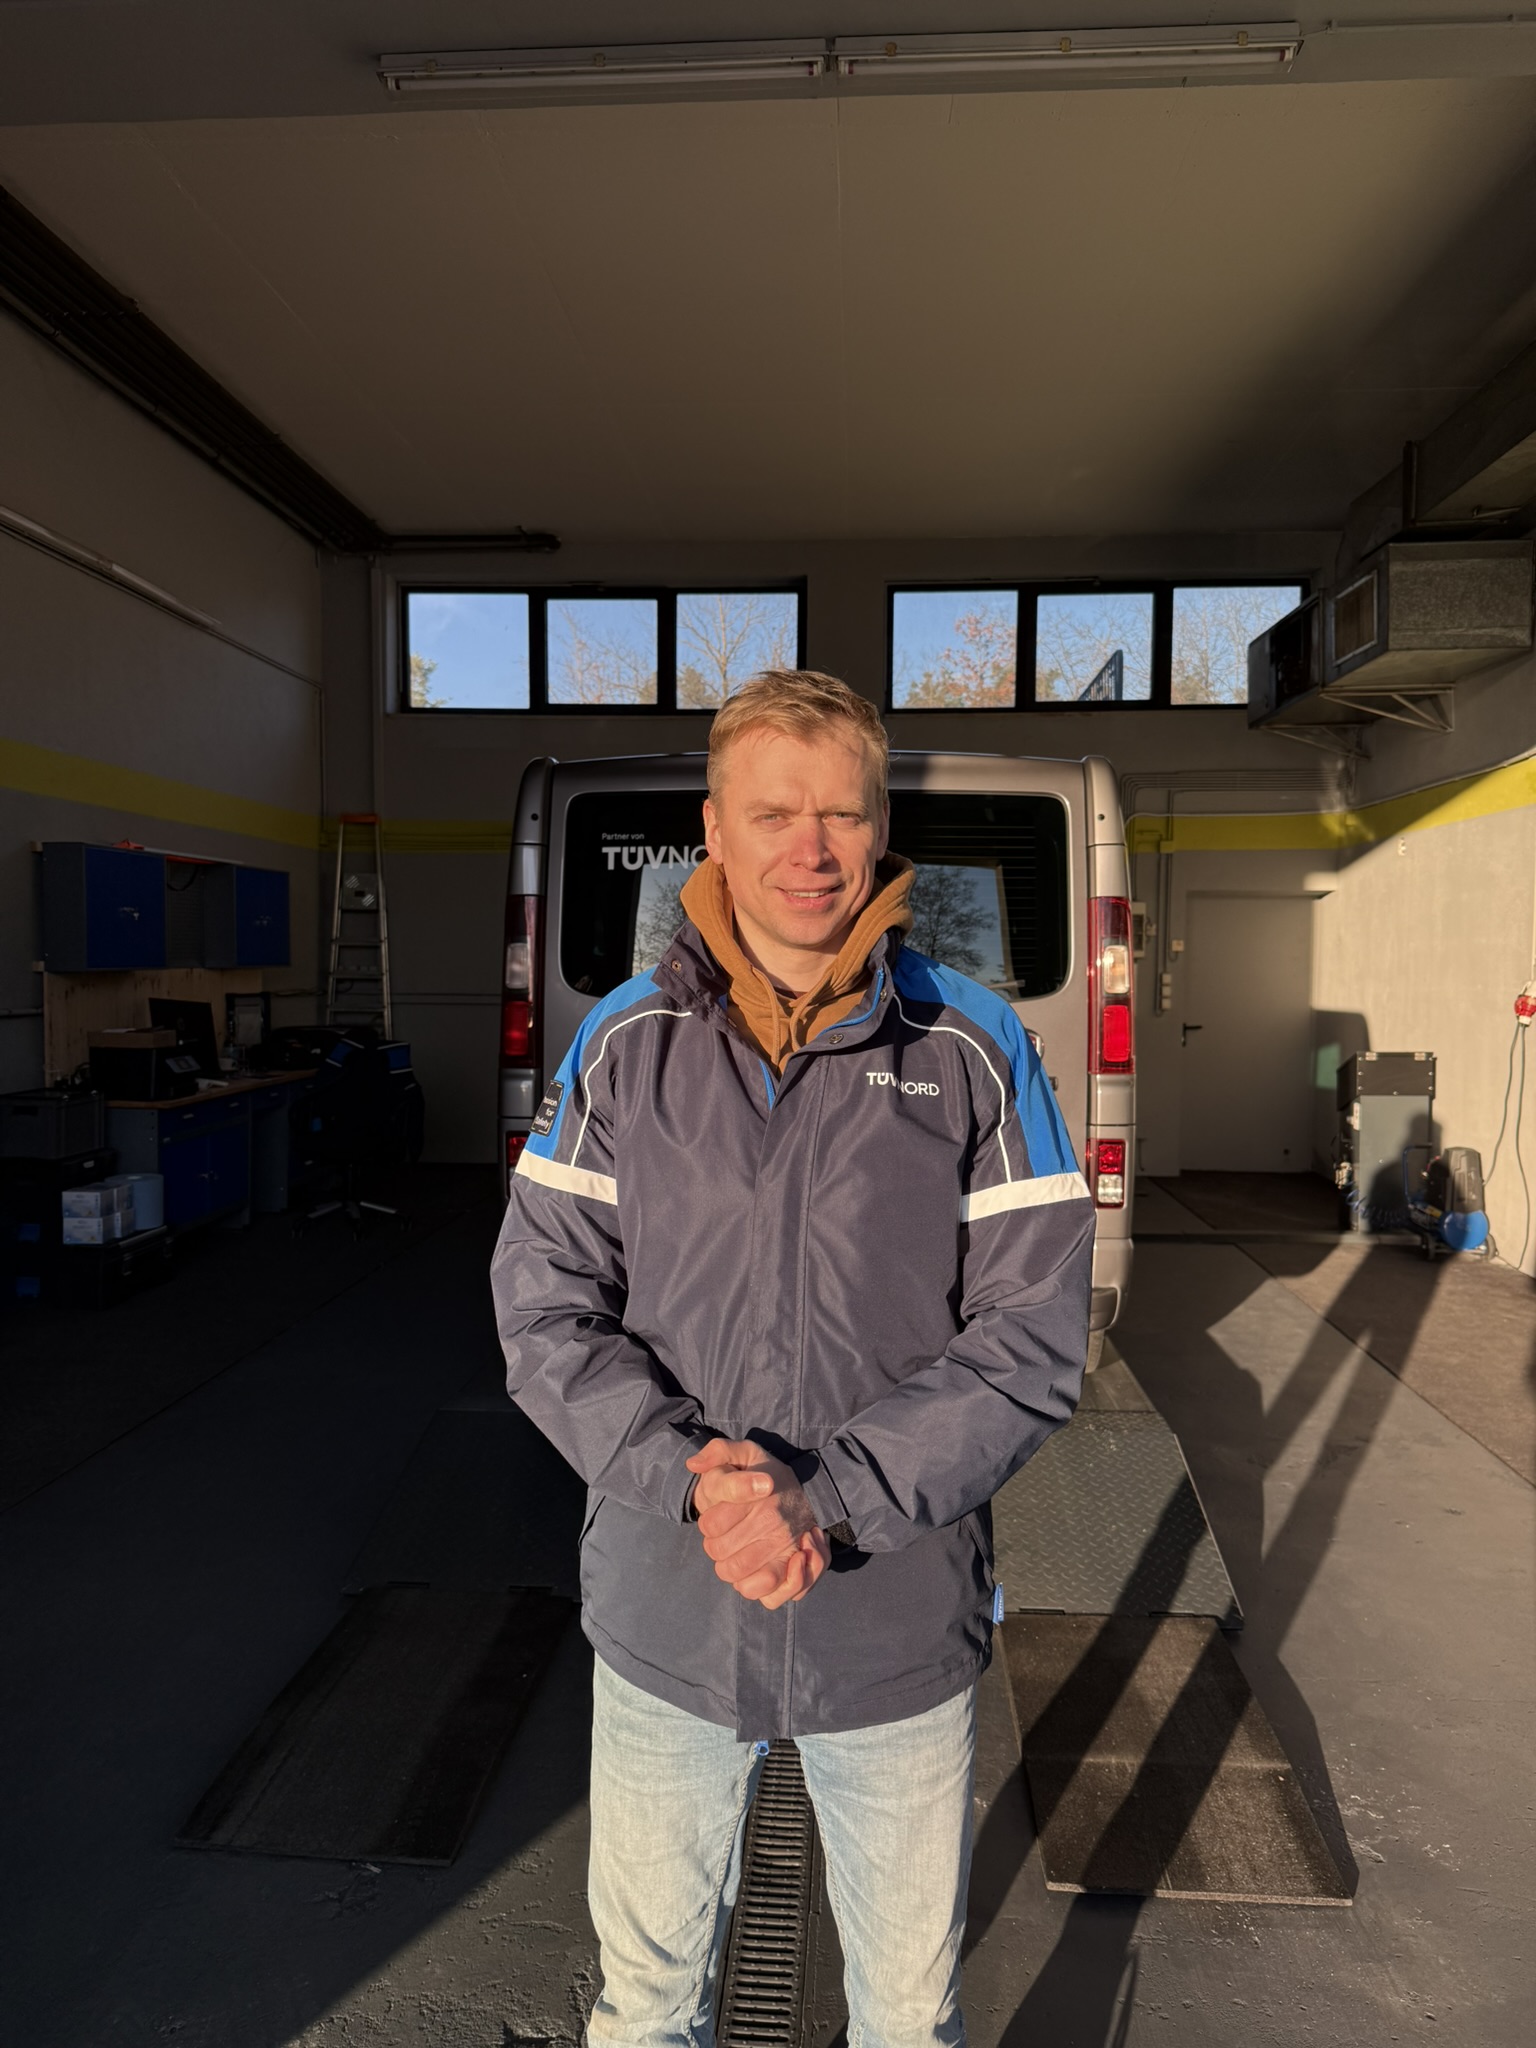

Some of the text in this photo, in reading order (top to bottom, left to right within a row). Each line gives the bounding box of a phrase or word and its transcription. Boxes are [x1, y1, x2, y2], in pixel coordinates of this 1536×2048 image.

[601, 832, 645, 841] Partner von
[601, 845, 710, 871] TÜVNO
[545, 1107, 555, 1117] for
